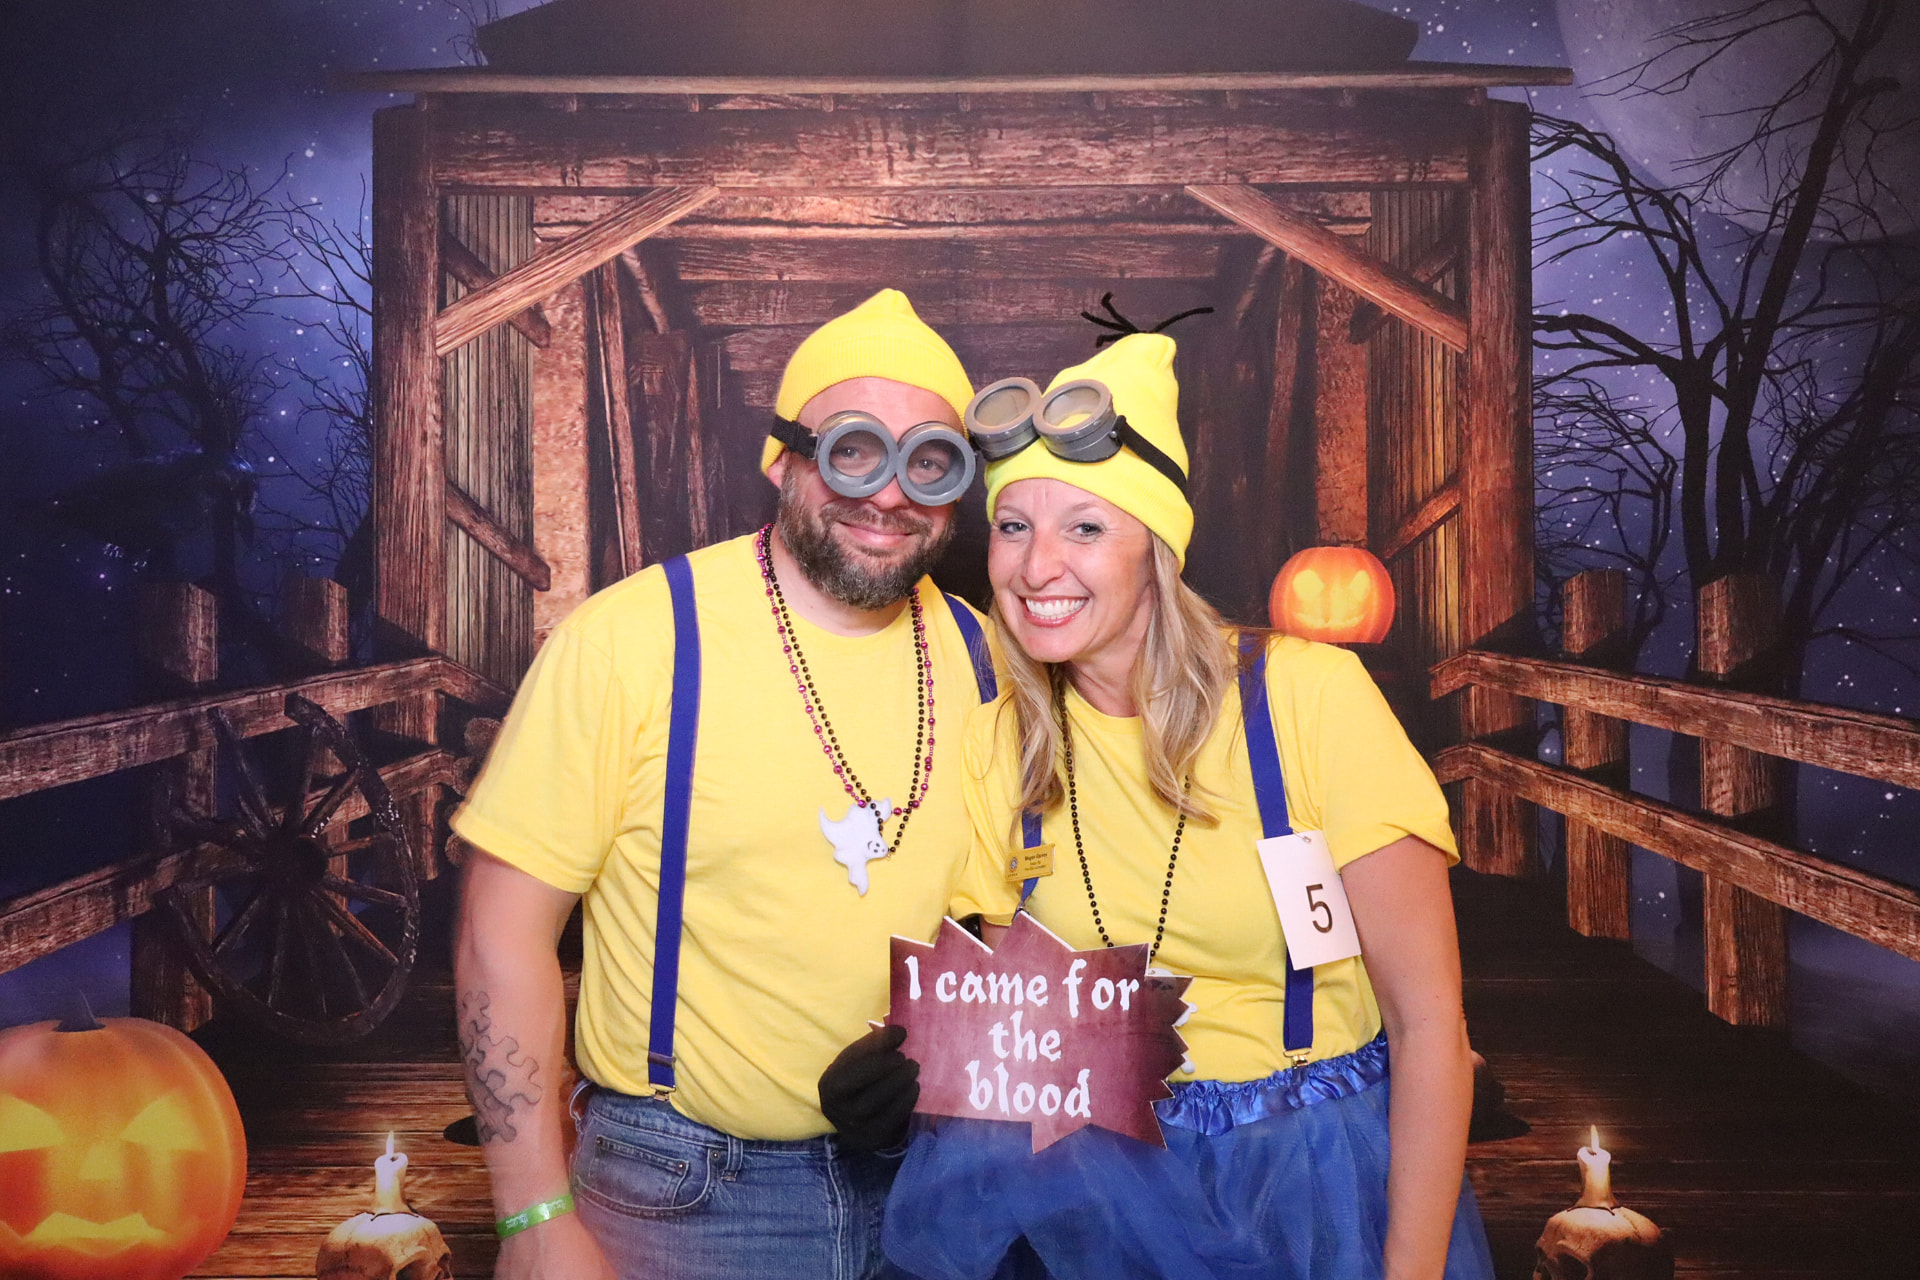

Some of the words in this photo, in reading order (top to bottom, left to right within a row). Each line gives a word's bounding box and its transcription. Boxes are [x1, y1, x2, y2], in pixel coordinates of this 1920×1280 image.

[1305, 883, 1333, 934] 5
[904, 955, 922, 1001] I
[935, 971, 1049, 1008] came
[1062, 958, 1140, 1019] for
[987, 1010, 1062, 1063] the
[964, 1059, 1092, 1118] blood
